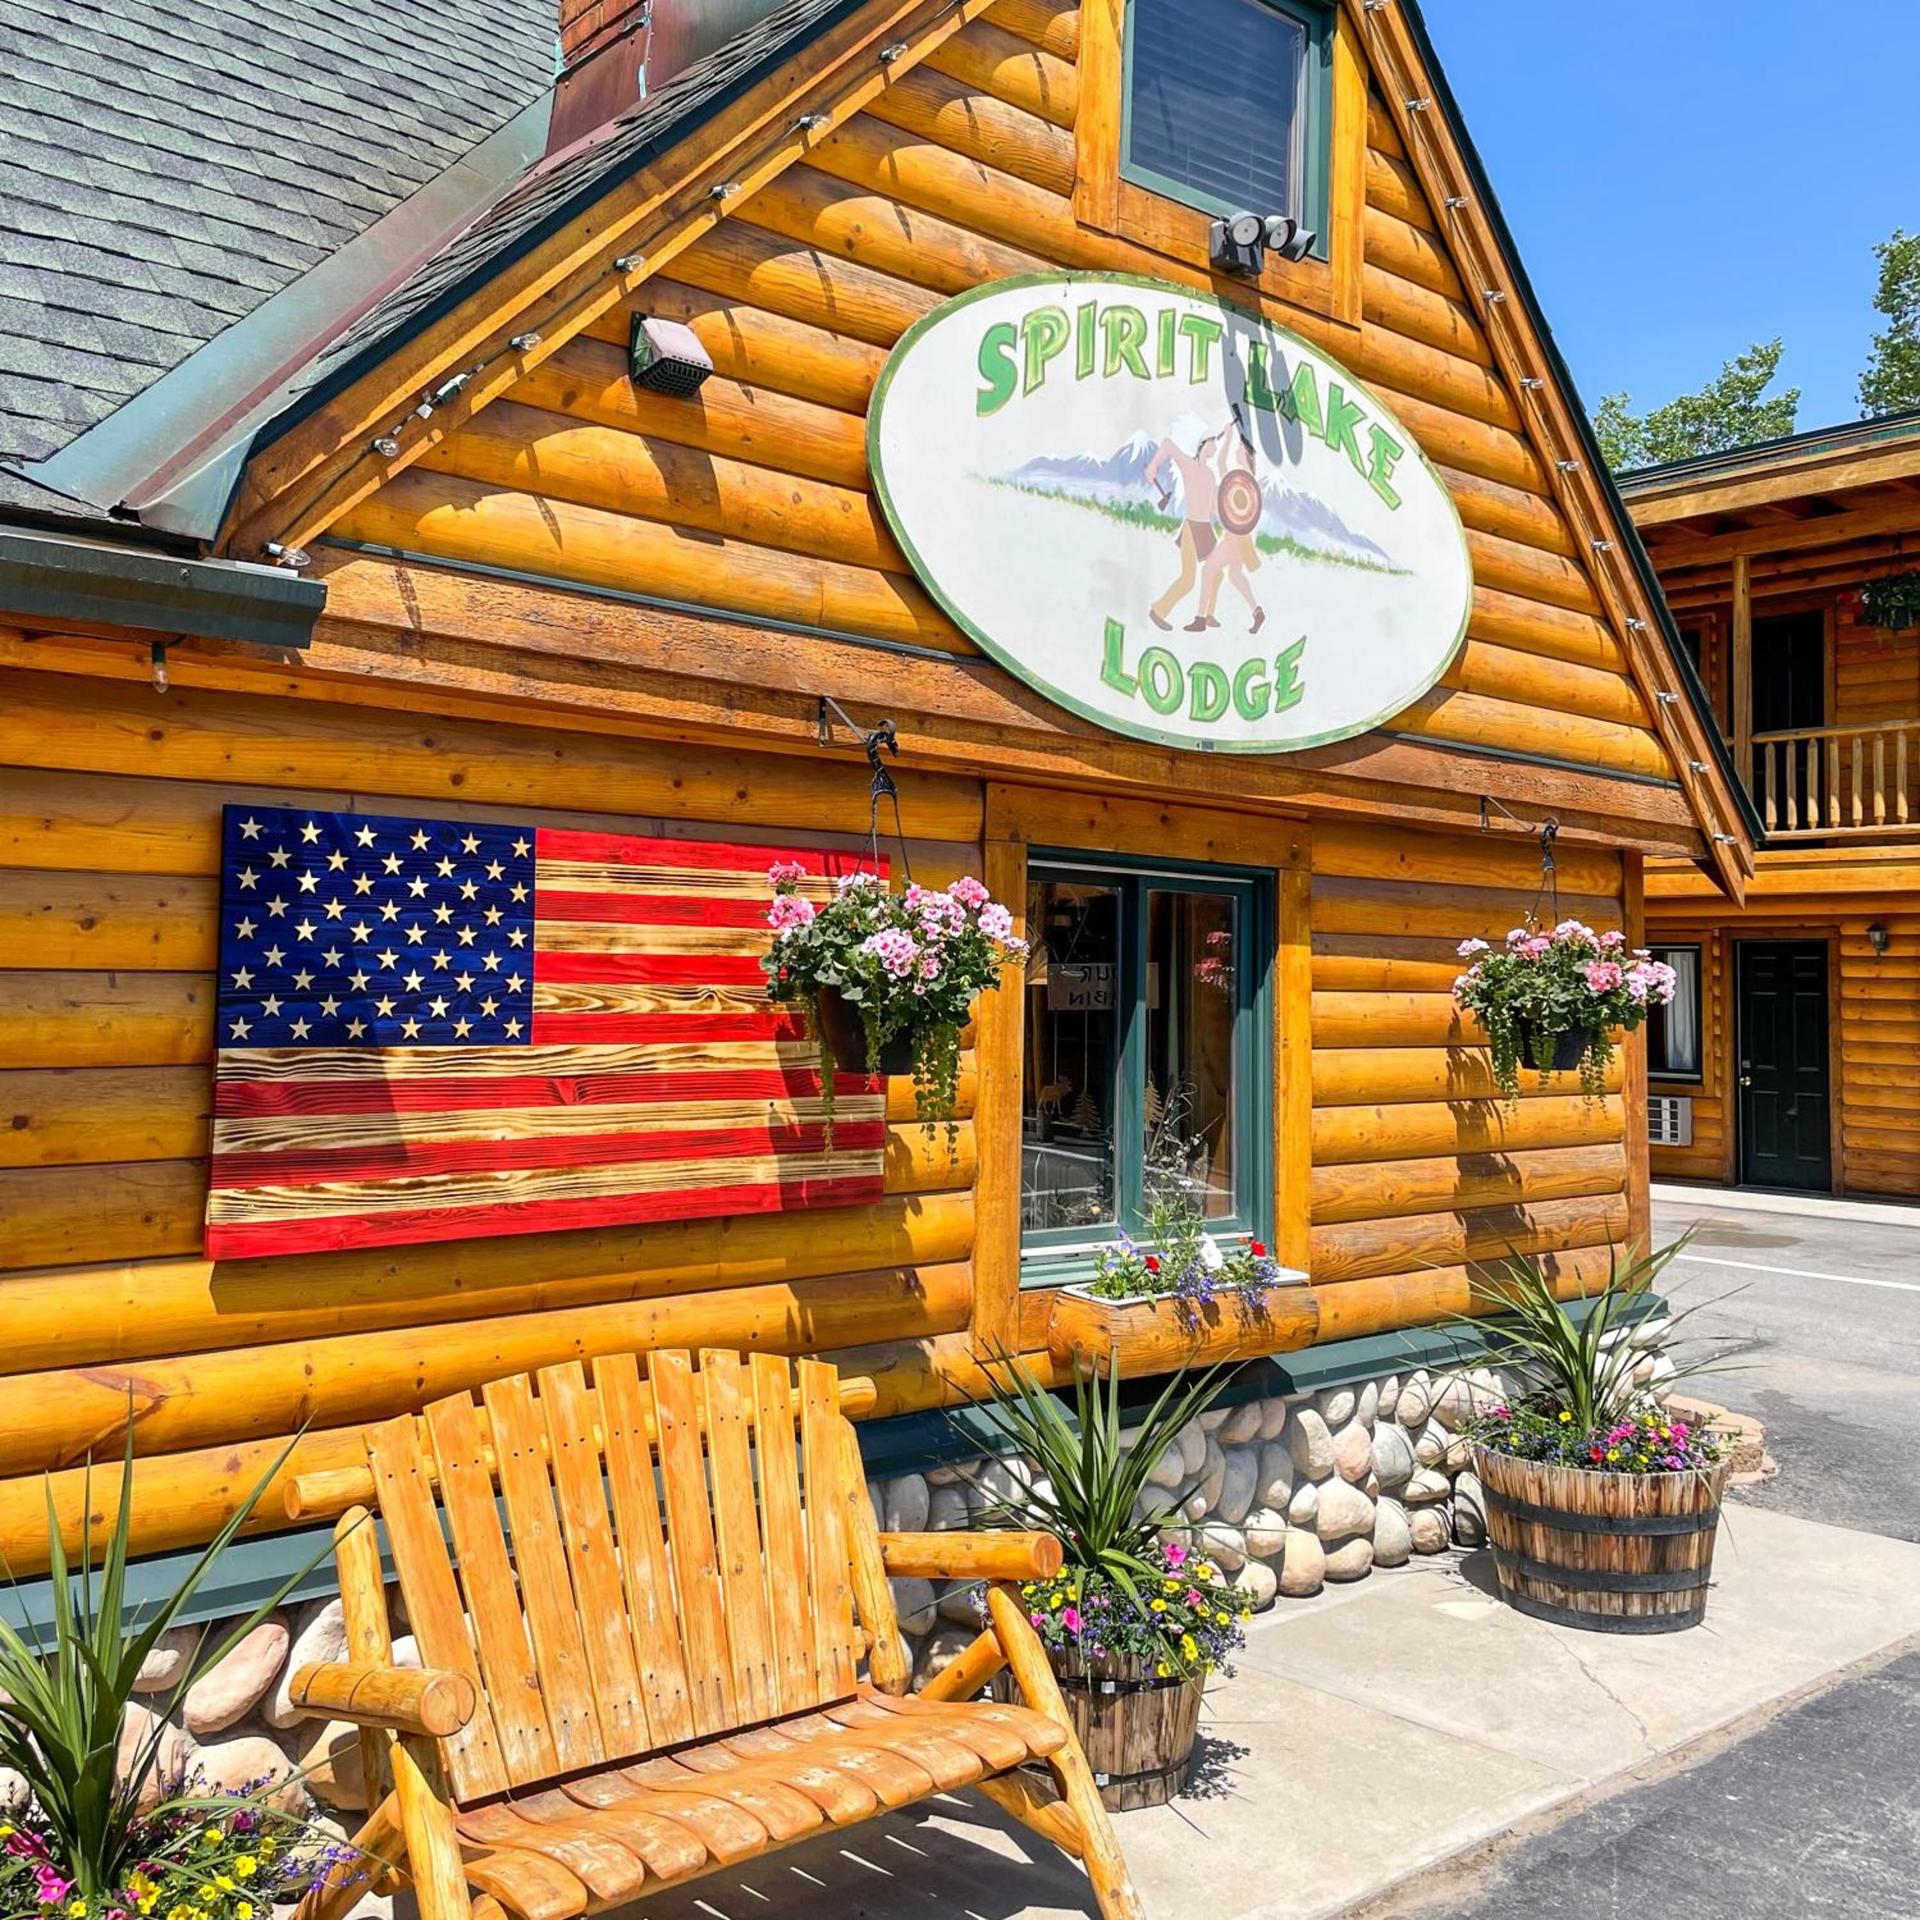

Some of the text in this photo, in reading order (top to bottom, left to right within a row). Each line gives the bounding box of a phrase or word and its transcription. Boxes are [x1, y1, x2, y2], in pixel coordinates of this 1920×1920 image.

[976, 299, 1405, 510] SPIRIT LAKE
[1101, 617, 1307, 722] LODGE
